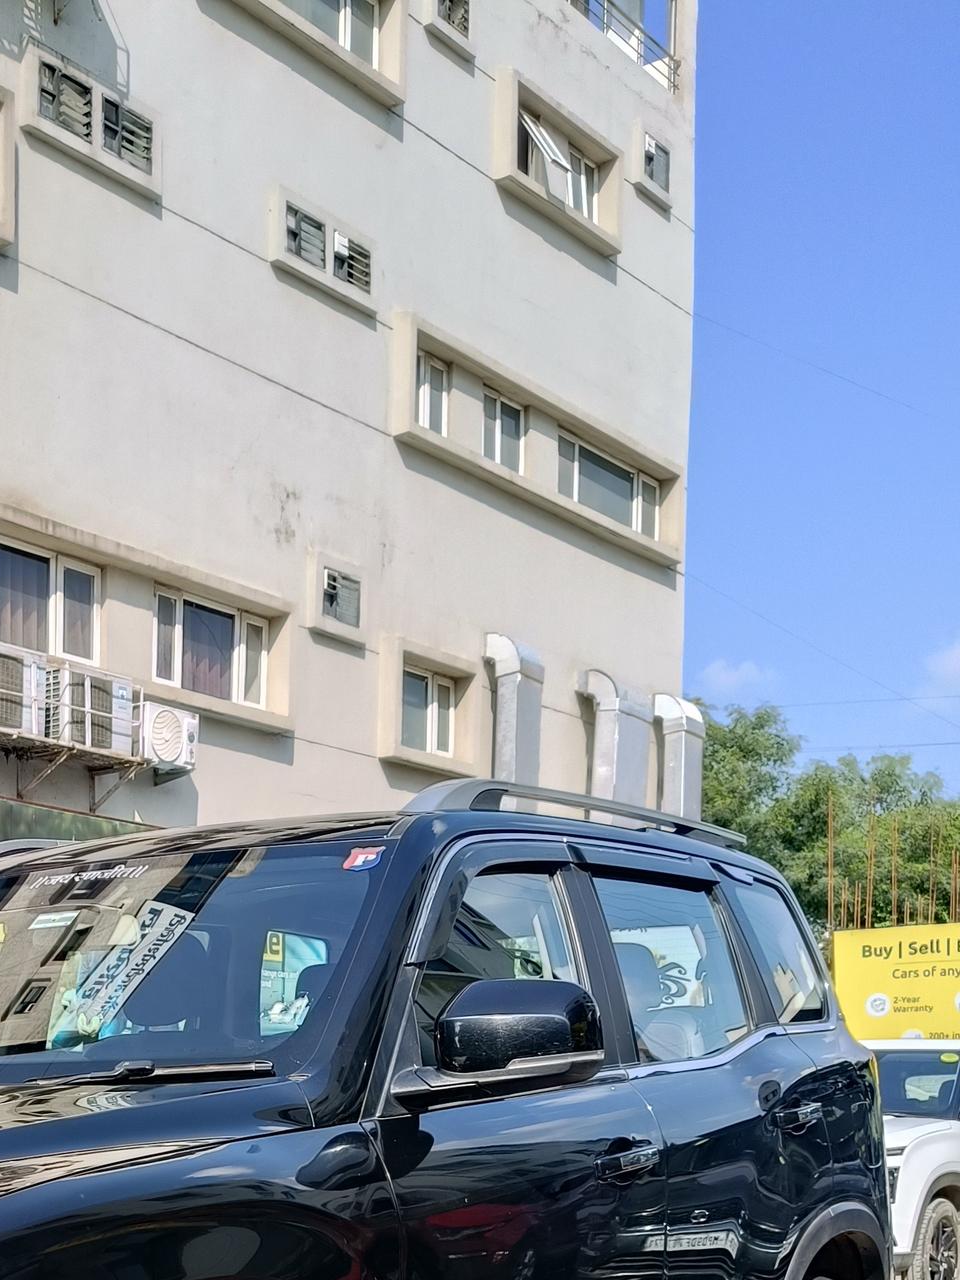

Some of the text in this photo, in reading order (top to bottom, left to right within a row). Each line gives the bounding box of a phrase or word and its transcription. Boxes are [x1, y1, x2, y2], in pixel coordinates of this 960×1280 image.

[862, 945, 892, 959] Buy
[908, 939, 941, 955] Sell
[892, 969, 919, 979] Cars
[923, 966, 936, 977] of
[893, 996, 920, 1004] 2-Year
[893, 1005, 933, 1013] Warranty
